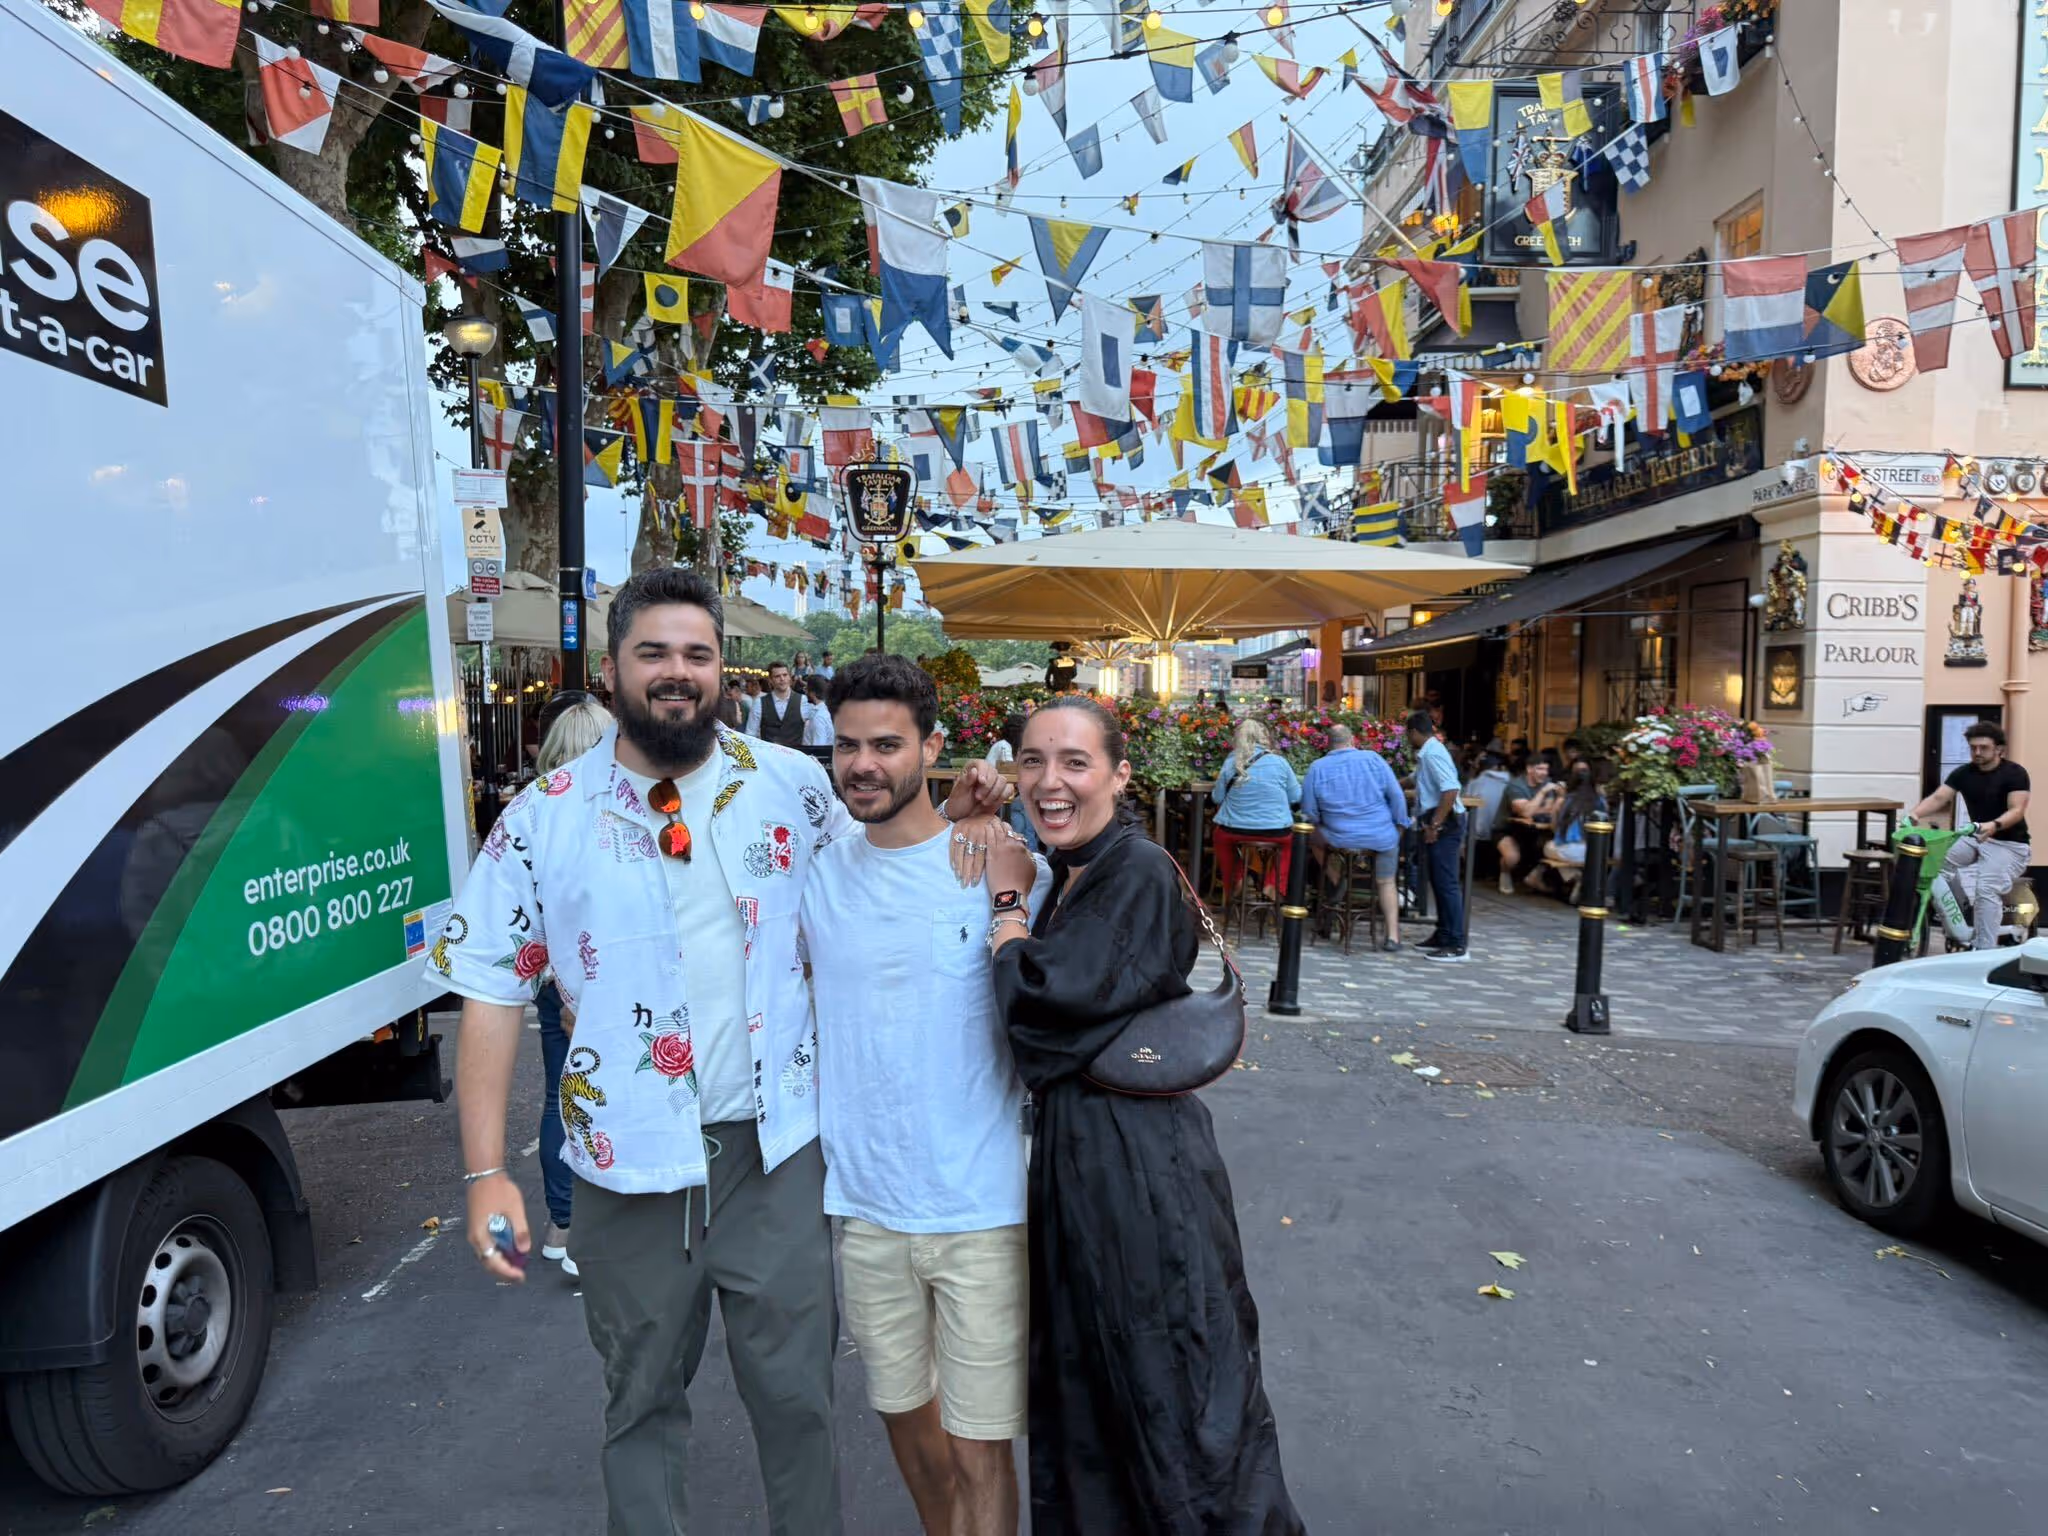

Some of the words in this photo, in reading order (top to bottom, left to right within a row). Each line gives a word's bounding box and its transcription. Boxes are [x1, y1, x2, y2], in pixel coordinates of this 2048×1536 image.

[0, 200, 150, 332] se
[856, 473, 901, 483] TRAFALGAR
[1647, 442, 1718, 487] TAVERN
[1873, 468, 1920, 482] STREET
[469, 535, 497, 544] CCTV
[1826, 593, 1919, 622] CRIBB'S
[1824, 644, 1919, 666] PARLOUR
[244, 836, 411, 905] enterprise.co.uk
[248, 905, 321, 957] 0800
[327, 889, 372, 930] 800
[377, 876, 414, 914] 227
